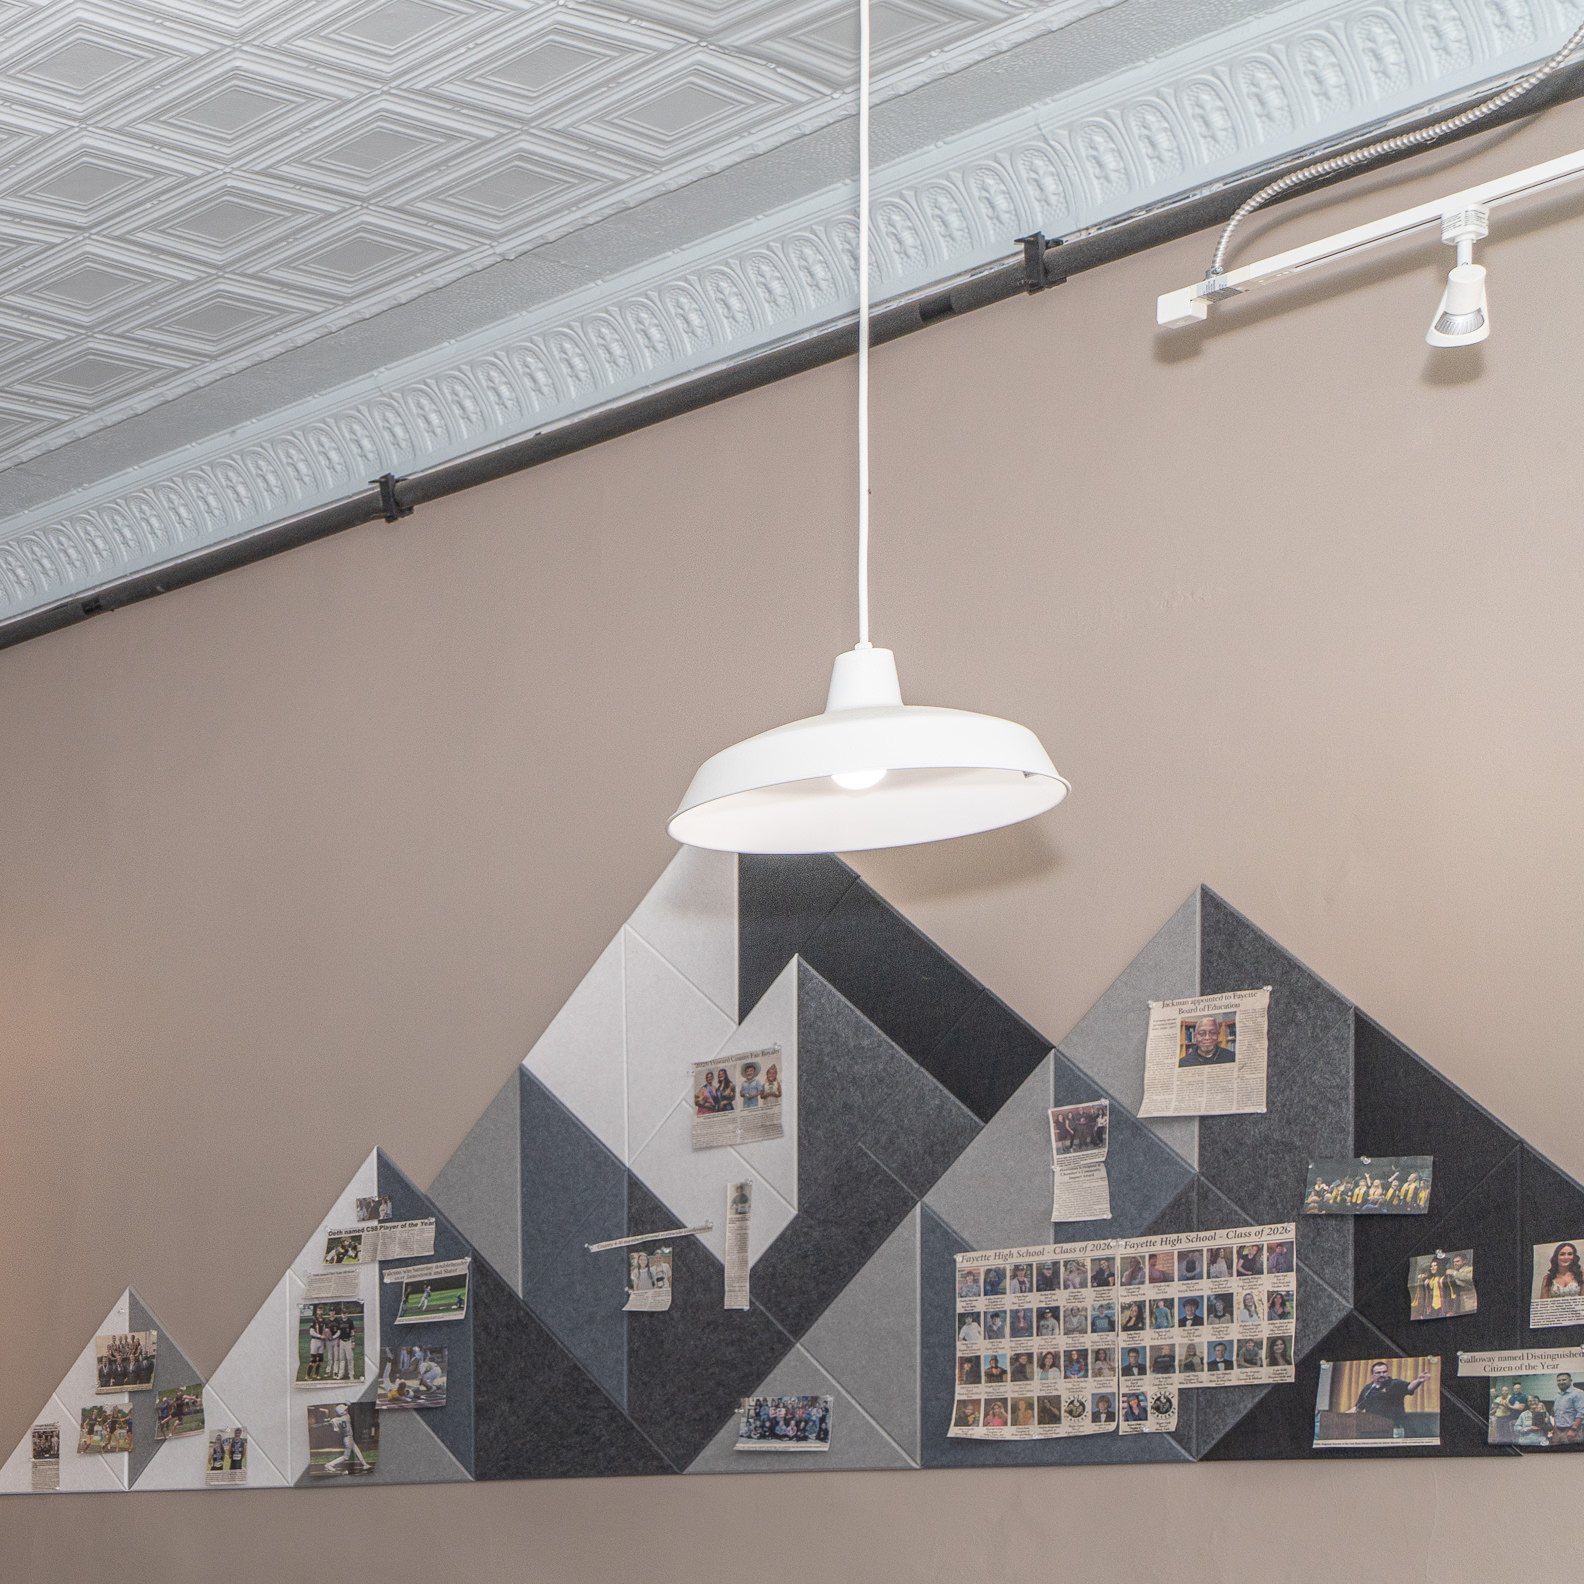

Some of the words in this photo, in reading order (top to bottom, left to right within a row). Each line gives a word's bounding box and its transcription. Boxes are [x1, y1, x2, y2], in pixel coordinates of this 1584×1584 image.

[1161, 1000, 1189, 1009] Jackman
[1189, 995, 1223, 1006] appointed
[1232, 991, 1258, 1000] Fayette
[1178, 1007, 1198, 1015] Board
[1198, 1005, 1207, 1013] of
[1207, 1002, 1241, 1011] Education
[379, 1223, 399, 1231] Player
[1124, 1239, 1157, 1251] Fayette
[1160, 1236, 1182, 1247] High
[1184, 1231, 1217, 1244] School
[1226, 1229, 1253, 1240] Class
[1254, 1227, 1266, 1239] of
[960, 1254, 991, 1265] Fayette
[993, 1250, 1014, 1262] High
[1016, 1247, 1045, 1258] School
[1053, 1244, 1077, 1255] Class
[1077, 1244, 1088, 1256] of
[1459, 1354, 1496, 1365] Galloway
[1497, 1352, 1524, 1361] named
[1483, 1364, 1513, 1373] Citizen
[1514, 1363, 1524, 1371] of
[1525, 1362, 1538, 1370] the
[1540, 1361, 1560, 1370] Year
